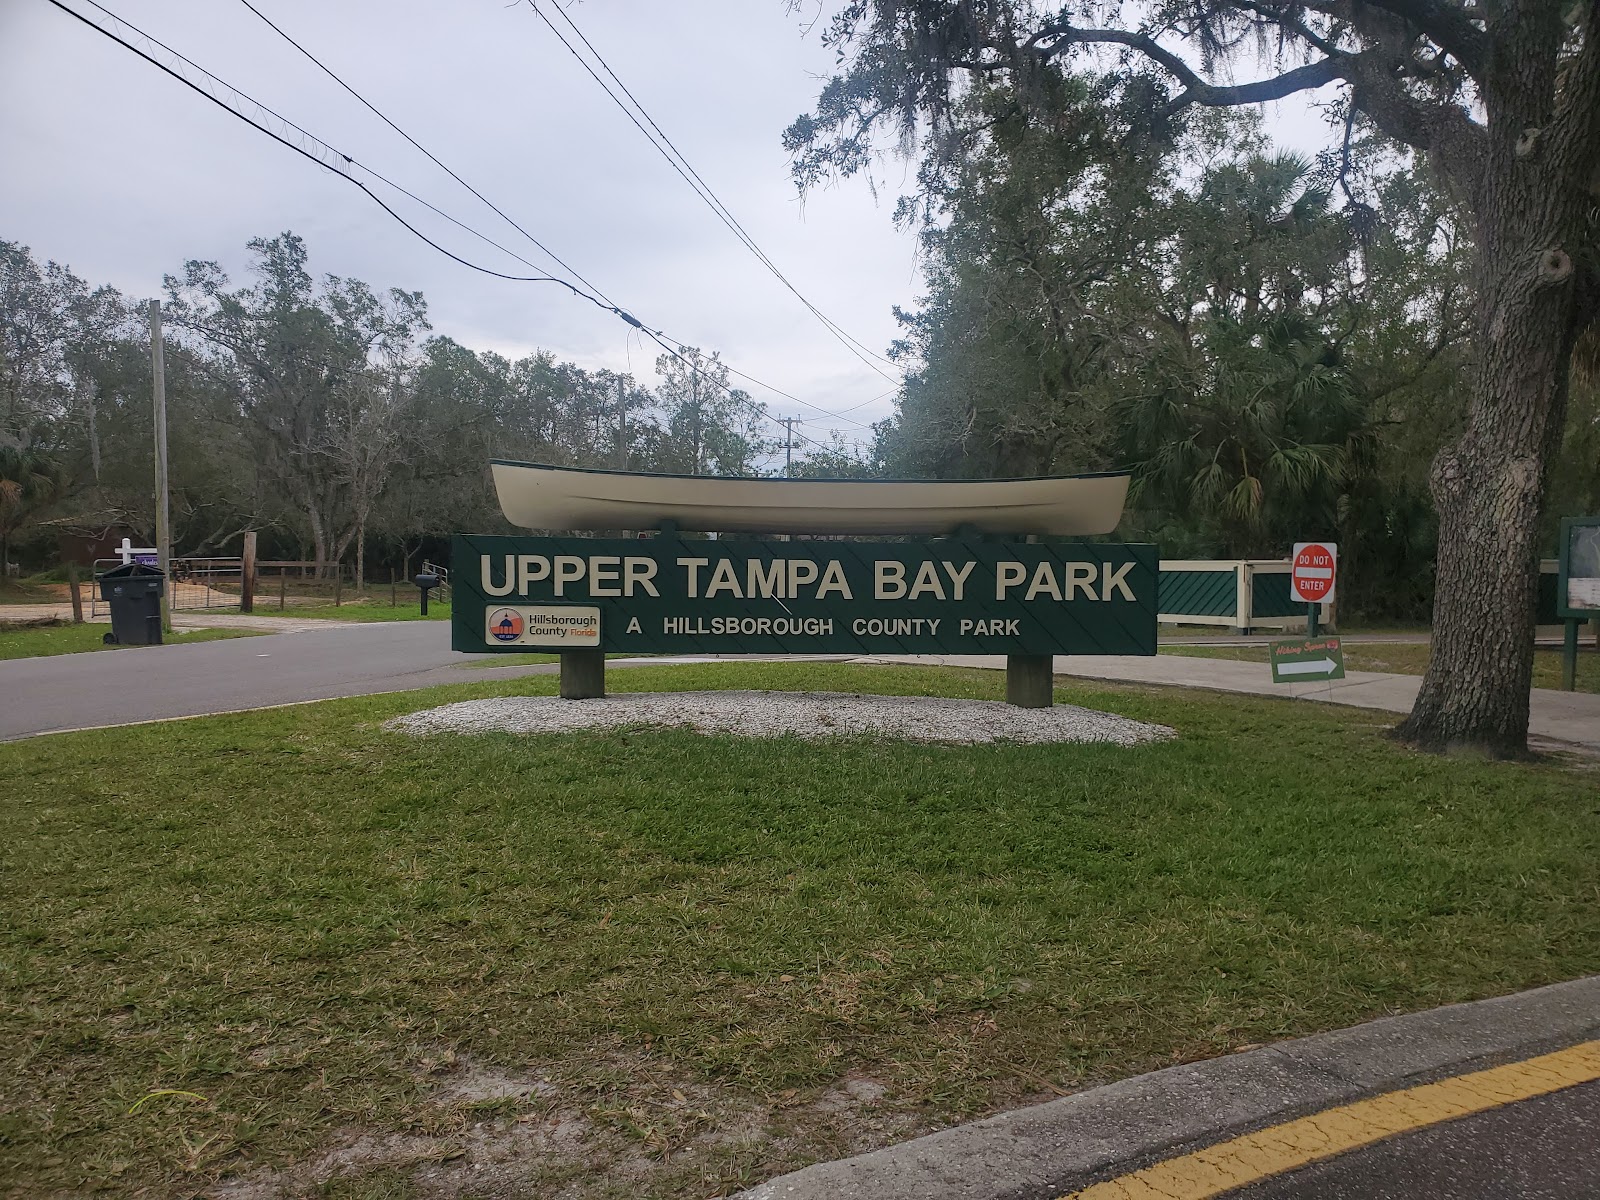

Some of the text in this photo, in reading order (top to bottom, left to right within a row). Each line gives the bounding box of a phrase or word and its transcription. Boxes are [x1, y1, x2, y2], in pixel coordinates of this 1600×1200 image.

[1299, 555, 1329, 565] DO NOT
[480, 554, 1138, 602] UPPER TAMPA BAY PARK
[1300, 580, 1324, 591] ENTER
[529, 614, 597, 628] Hillsborough
[625, 616, 1020, 636] A HILLSBOROUGH COUNTY PARK
[529, 626, 597, 638] County Florida
